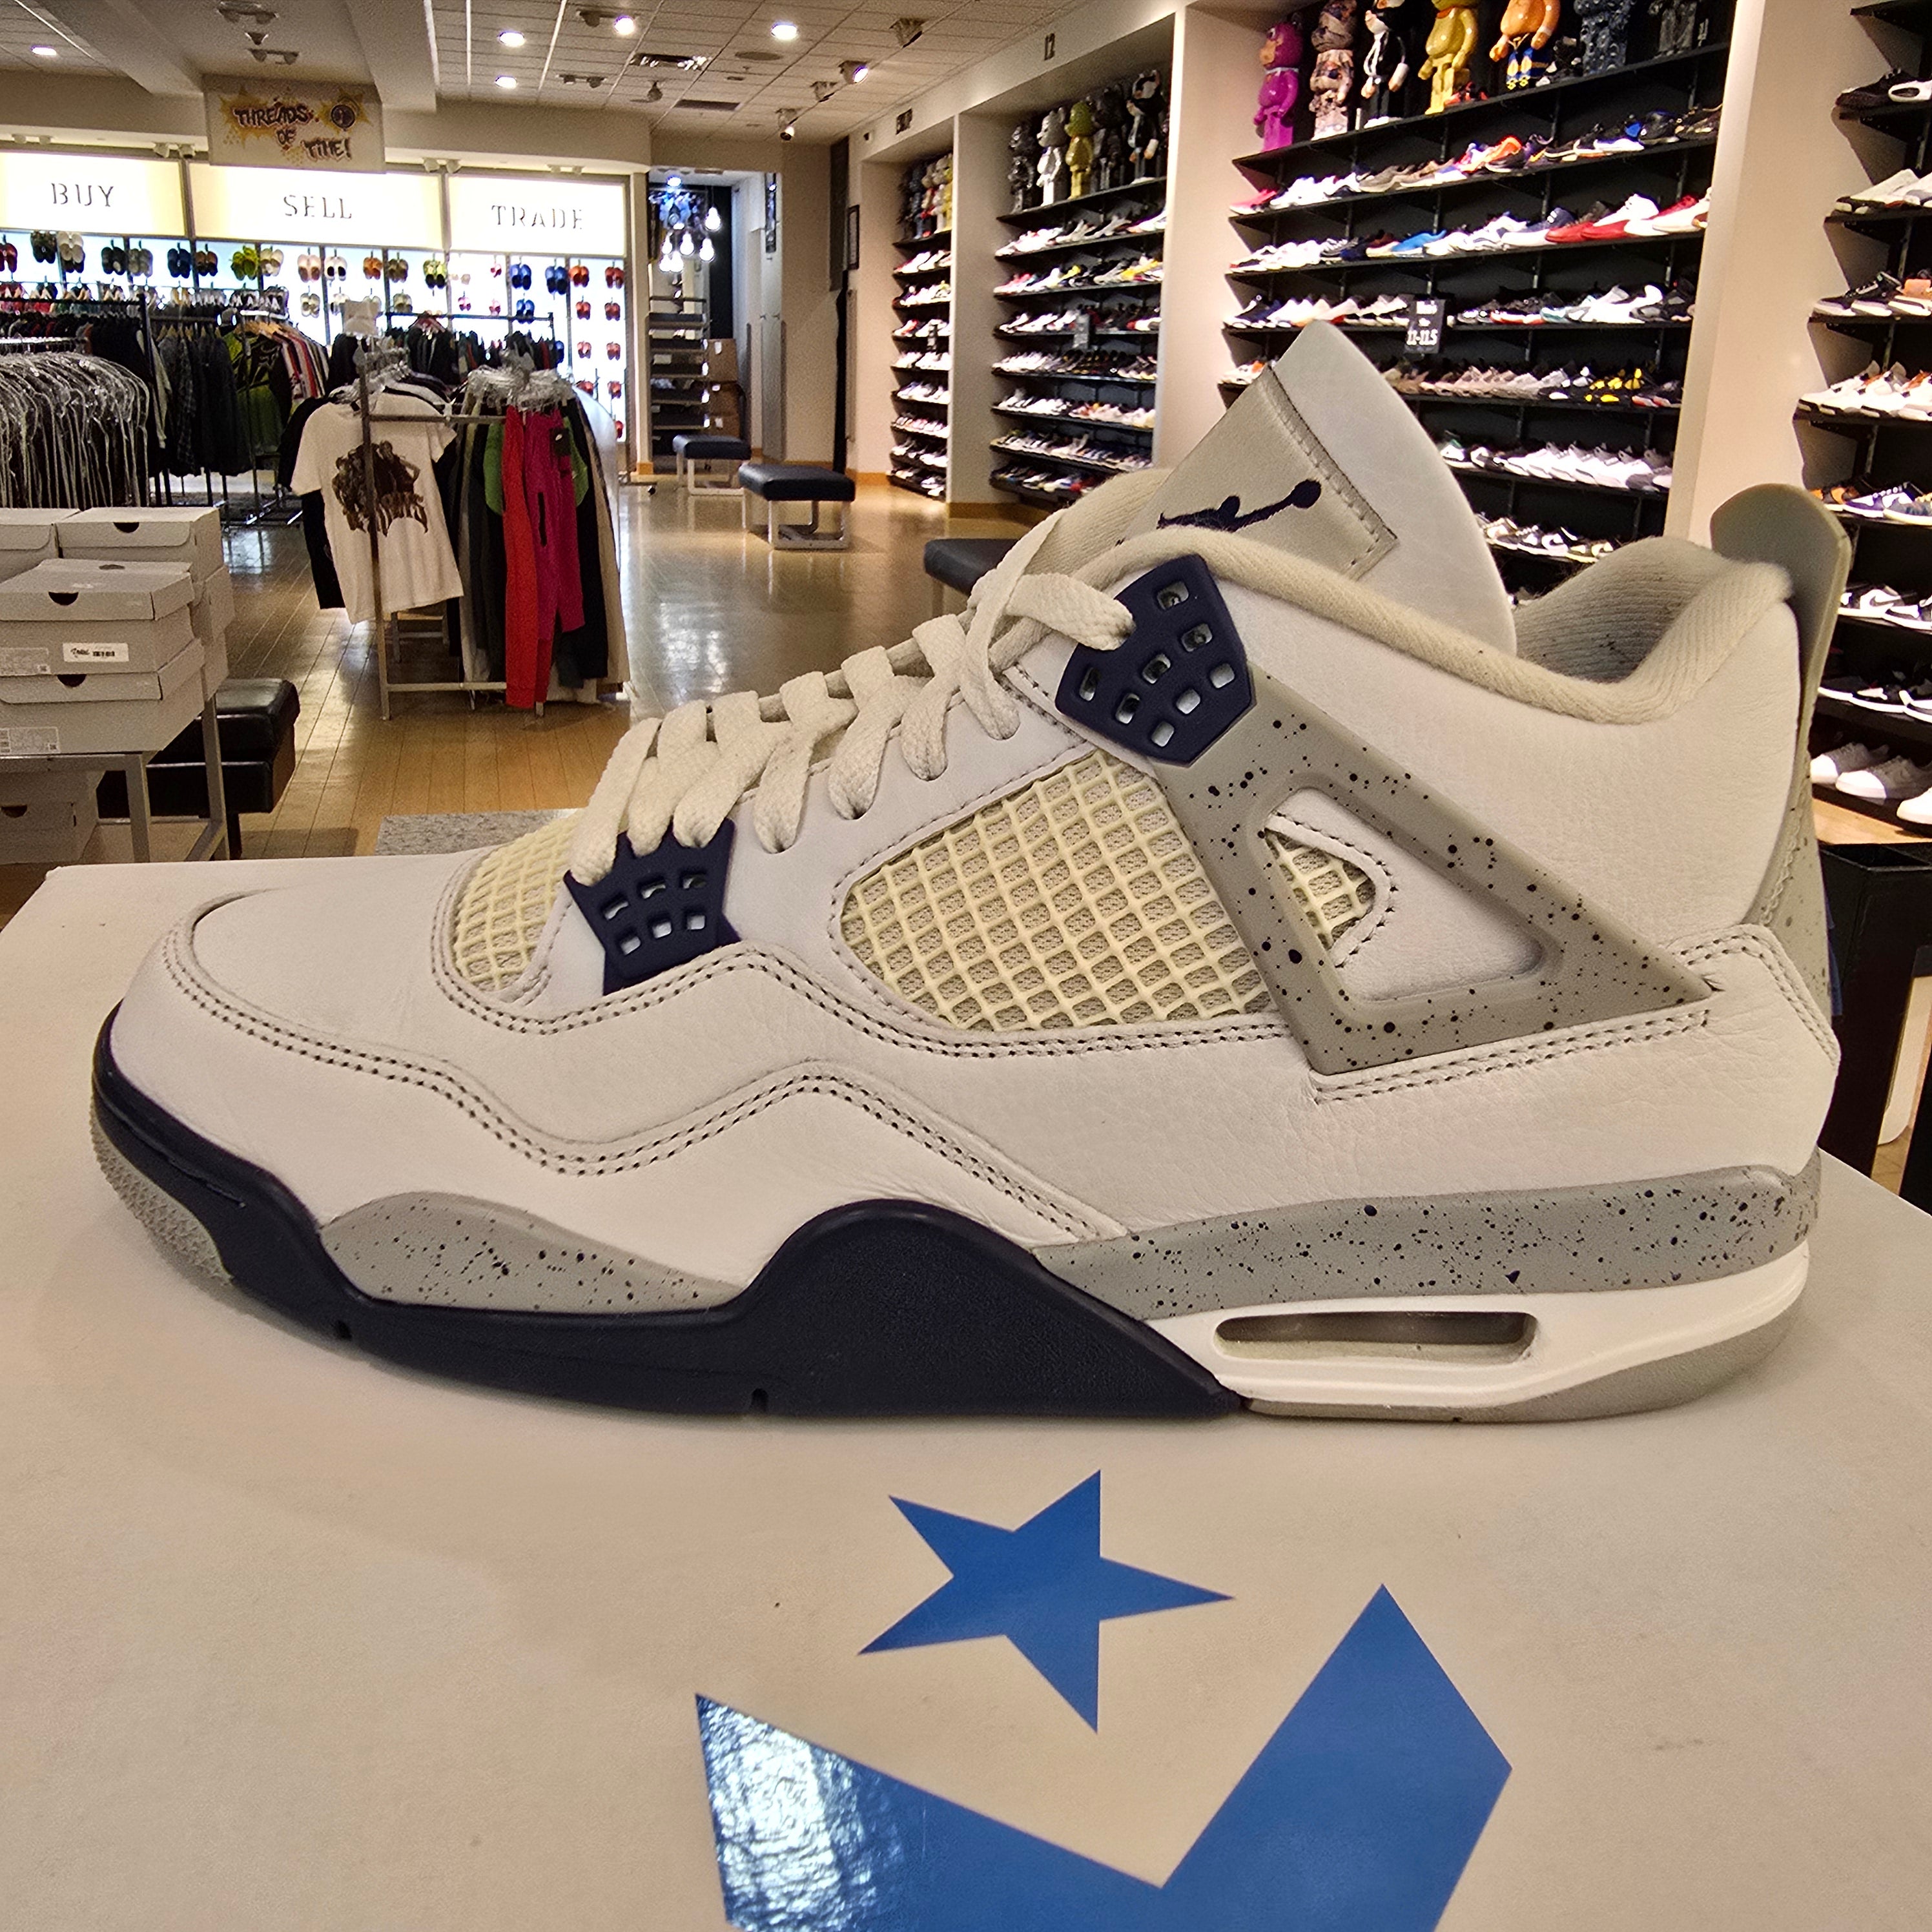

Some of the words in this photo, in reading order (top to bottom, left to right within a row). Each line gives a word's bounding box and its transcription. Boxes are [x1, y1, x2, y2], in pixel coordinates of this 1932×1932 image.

[233, 101, 310, 127] THREADS
[276, 128, 296, 145] OF
[51, 183, 114, 207] BUY
[283, 194, 352, 219] SELL
[491, 205, 582, 229] TRADE
